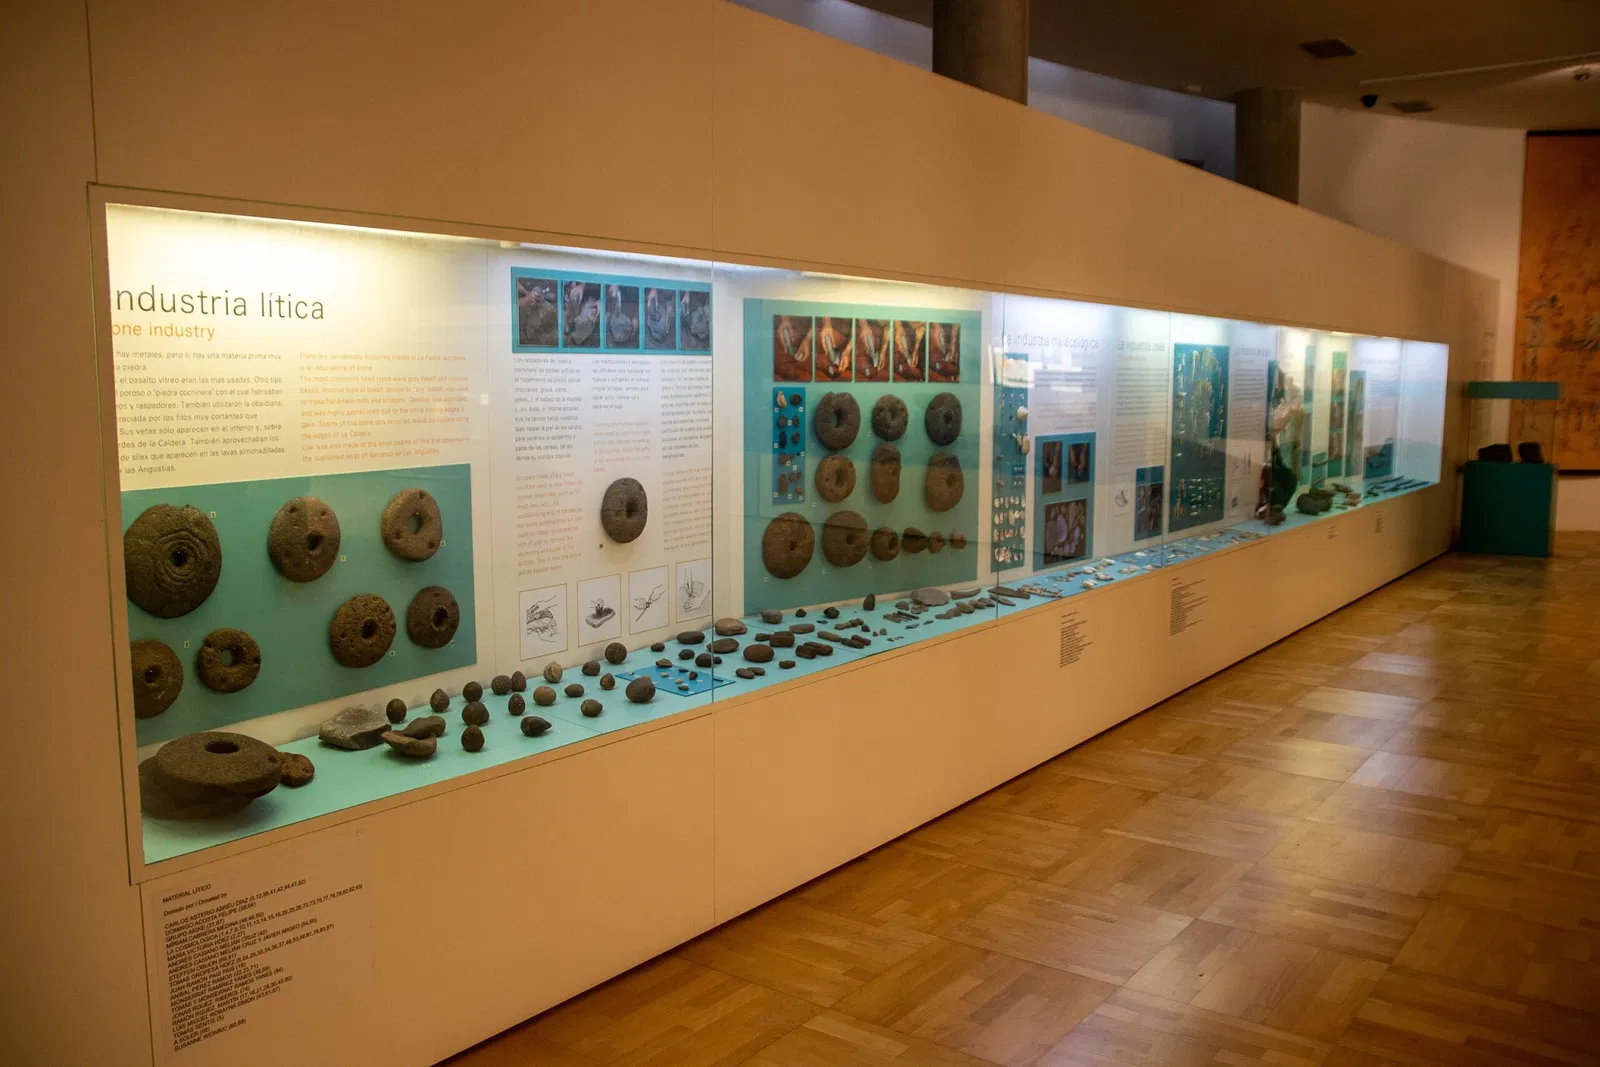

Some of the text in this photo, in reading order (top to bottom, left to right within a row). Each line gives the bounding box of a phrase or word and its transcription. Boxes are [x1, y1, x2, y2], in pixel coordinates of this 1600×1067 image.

[260, 291, 325, 321] lítica
[149, 322, 215, 341] industry
[167, 352, 183, 360] pero
[193, 350, 205, 360] hay
[221, 351, 246, 359] materia
[248, 351, 266, 361] prima
[268, 353, 281, 361] muy
[129, 375, 156, 384] basalto
[199, 375, 208, 383] las
[254, 375, 269, 383] Otro
[270, 375, 283, 385] tipo
[120, 390, 145, 398] poroso
[181, 399, 211, 408] También
[163, 413, 174, 421] los
[176, 413, 192, 421] filos
[194, 414, 209, 422] muy
[211, 411, 243, 420] cortantes
[245, 413, 258, 421] que
[119, 427, 134, 435] Sus
[135, 426, 157, 435] vetas
[176, 426, 209, 435] aparecen
[263, 422, 282, 430] sobre
[190, 436, 221, 445] También
[269, 433, 279, 442] los
[150, 453, 164, 461] que
[166, 451, 198, 460] aparecen
[124, 465, 136, 474] las
[162, 883, 211, 903] MATERIAL LÍTICO
[163, 906, 184, 917] Donado
[197, 894, 220, 905] Donated
[164, 918, 188, 930] CARLOS
[189, 909, 214, 921] ASTERIO
[235, 897, 248, 906] DÍAZ
[165, 908, 237, 936] DOMINGO ACOSTA FELIPE
[188, 921, 238, 941] CABRERA MEDINA
[186, 942, 213, 955] VICTORIA
[193, 946, 218, 959] CASIANO
[241, 932, 256, 942] CRUZ
[193, 952, 219, 965] CASIANO
[241, 939, 256, 948] CRUZ
[211, 973, 232, 985] RAMOS
[234, 977, 254, 989] RAMOS
[169, 984, 185, 994] JUAN
[172, 1023, 186, 1032] LUIS
[186, 1014, 208, 1027] MIGUEL
[174, 1036, 202, 1051] SUSANNE
[178, 1031, 198, 1043] SOLER
